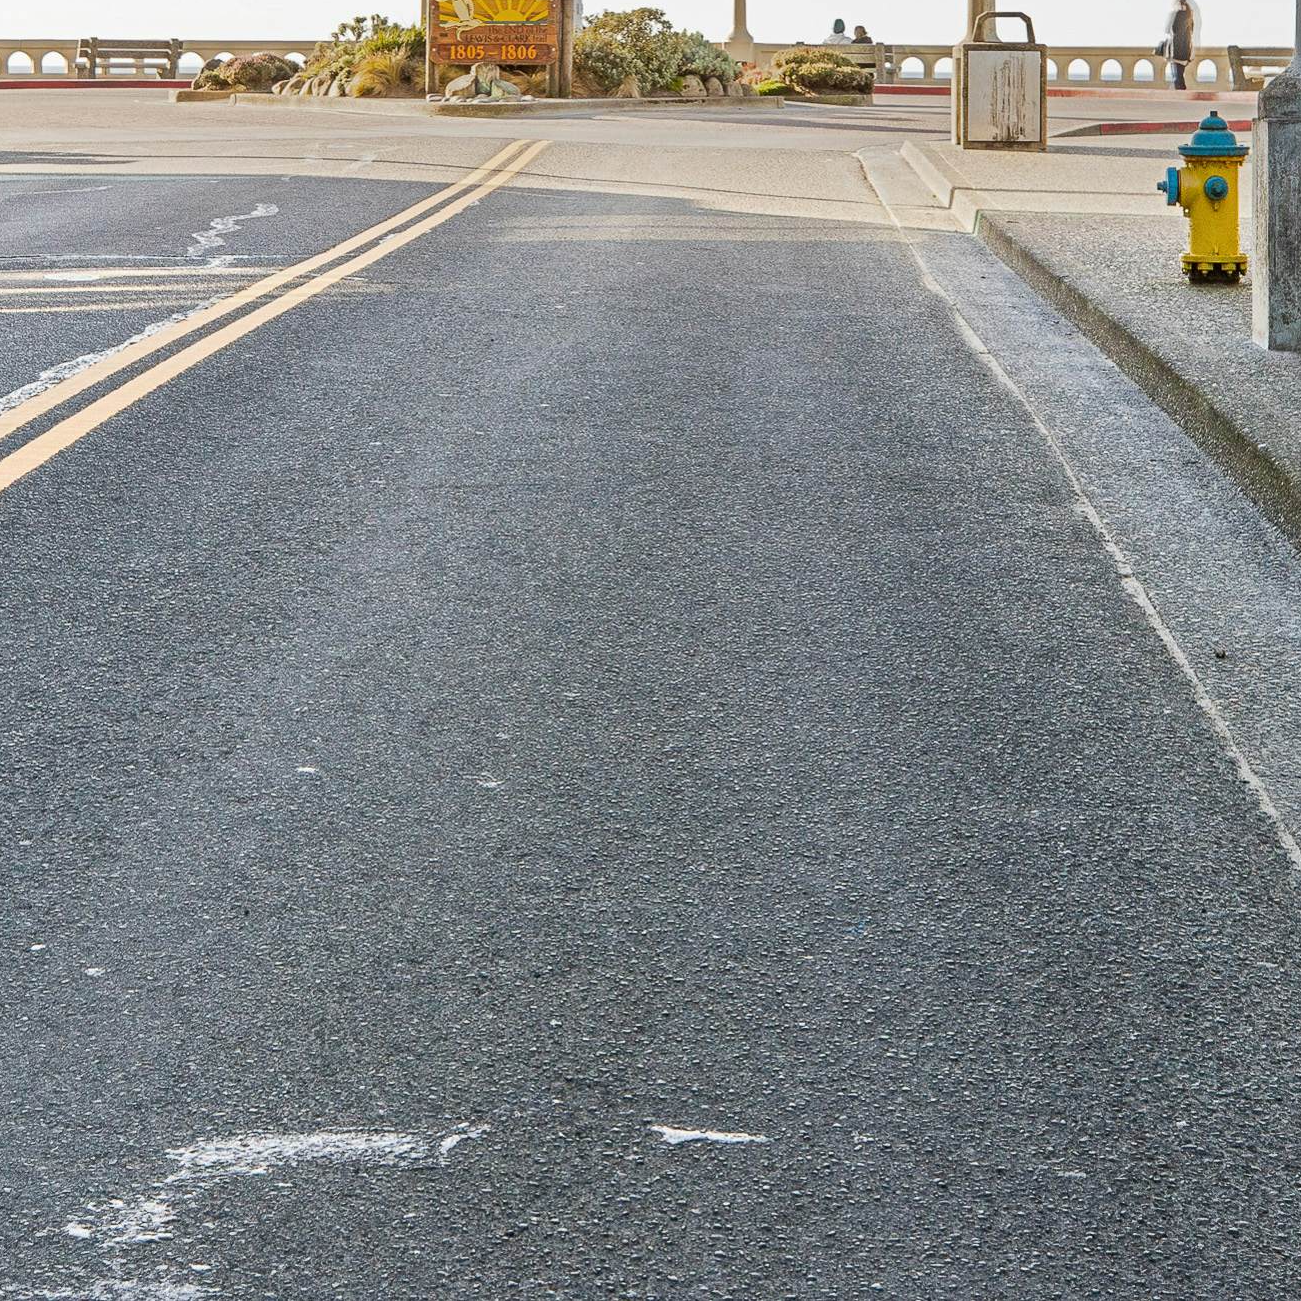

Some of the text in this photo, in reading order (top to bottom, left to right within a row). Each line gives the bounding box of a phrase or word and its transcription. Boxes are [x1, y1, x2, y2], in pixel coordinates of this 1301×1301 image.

[465, 34, 493, 43] LEWIS
[502, 34, 531, 43] CLARK
[450, 45, 485, 60] 1805
[501, 44, 537, 60] 1806
